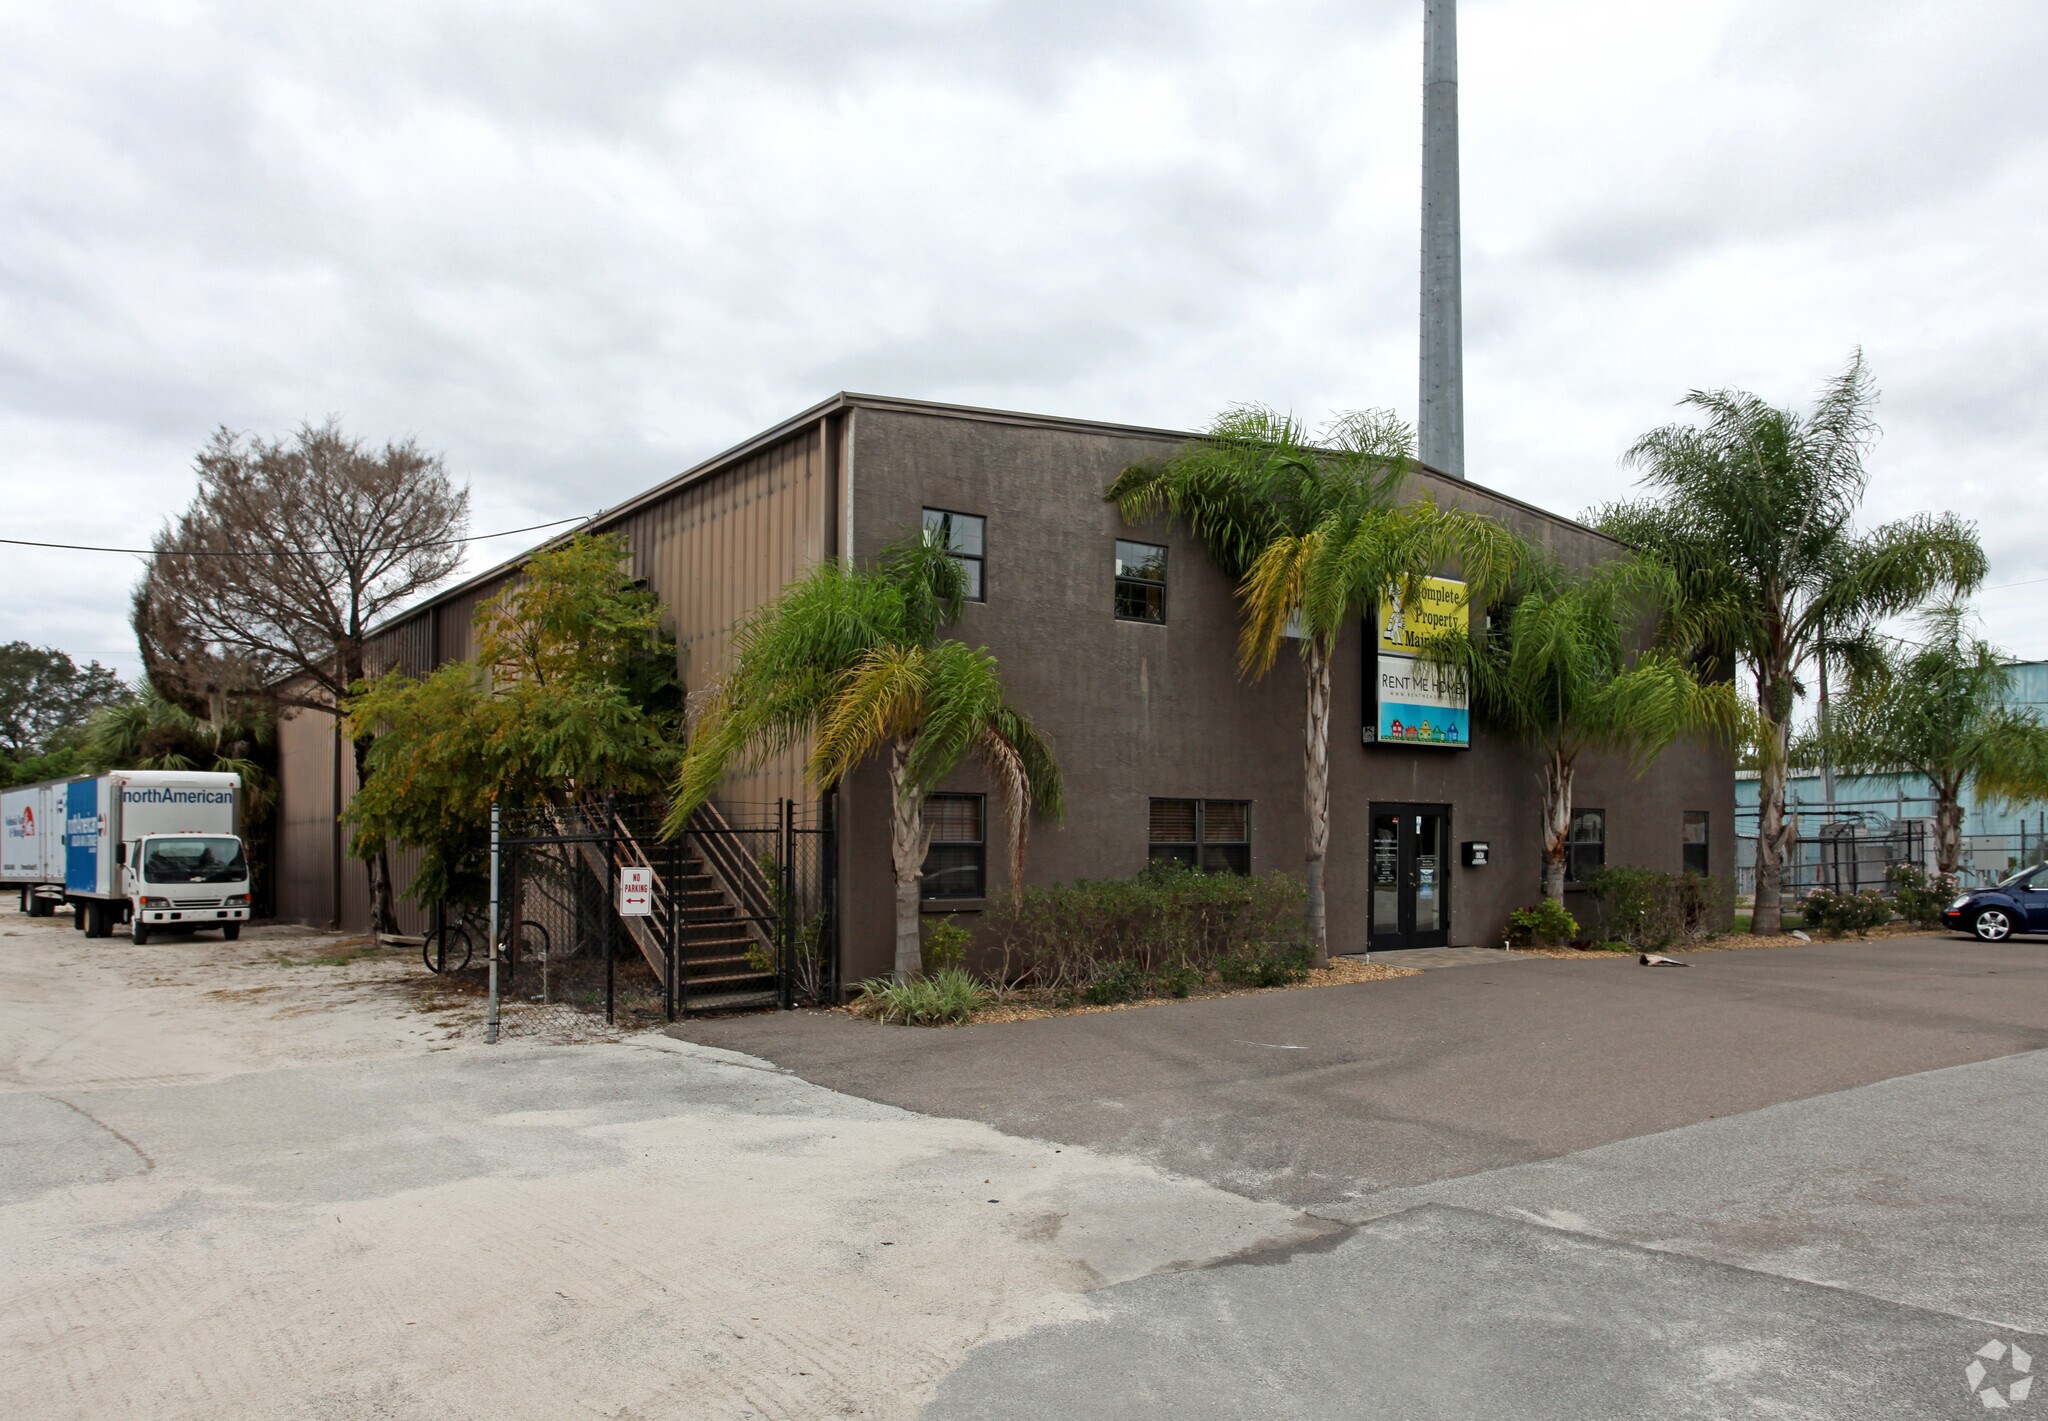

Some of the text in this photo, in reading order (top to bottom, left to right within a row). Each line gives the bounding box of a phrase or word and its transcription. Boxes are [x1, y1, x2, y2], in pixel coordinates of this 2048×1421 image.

[1417, 586, 1460, 606] omplete
[1382, 673, 1410, 690] RENT
[1413, 677, 1429, 692] ME
[123, 788, 232, 804] northAmerican
[632, 873, 641, 882] NO
[624, 884, 648, 893] PARKING
